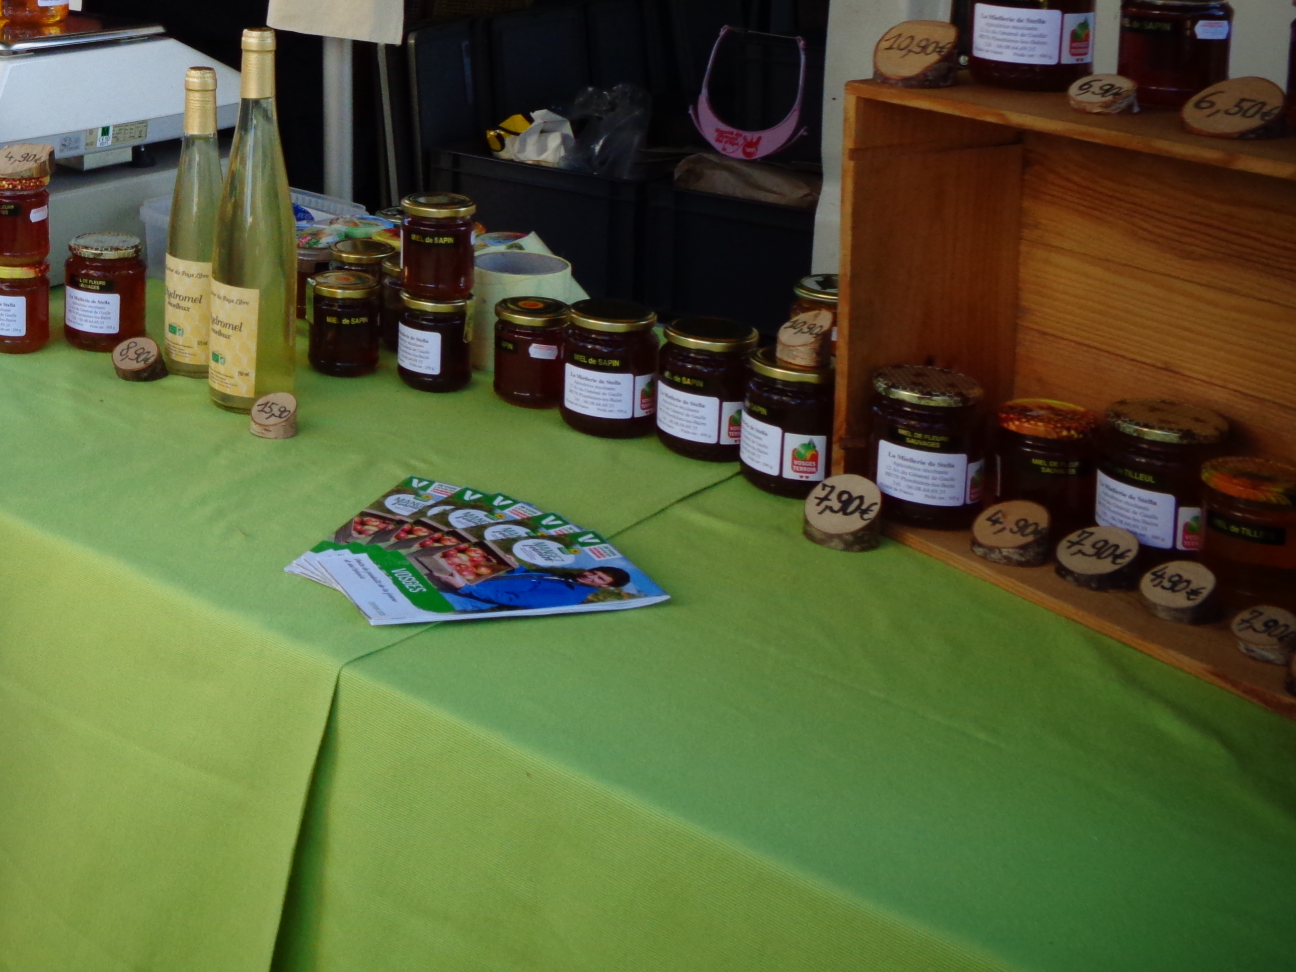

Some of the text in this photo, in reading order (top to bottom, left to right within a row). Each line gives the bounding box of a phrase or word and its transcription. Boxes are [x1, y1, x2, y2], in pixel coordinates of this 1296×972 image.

[1193, 91, 1283, 122] 6,50€
[4, 151, 44, 165] 4,90€
[434, 236, 454, 244] SAPIN
[597, 359, 620, 367] SAPIN
[814, 483, 878, 521] 7,90€
[1066, 529, 1133, 566] 7,90€
[391, 567, 427, 594] VOSGES
[1150, 566, 1207, 602] 4,90€
